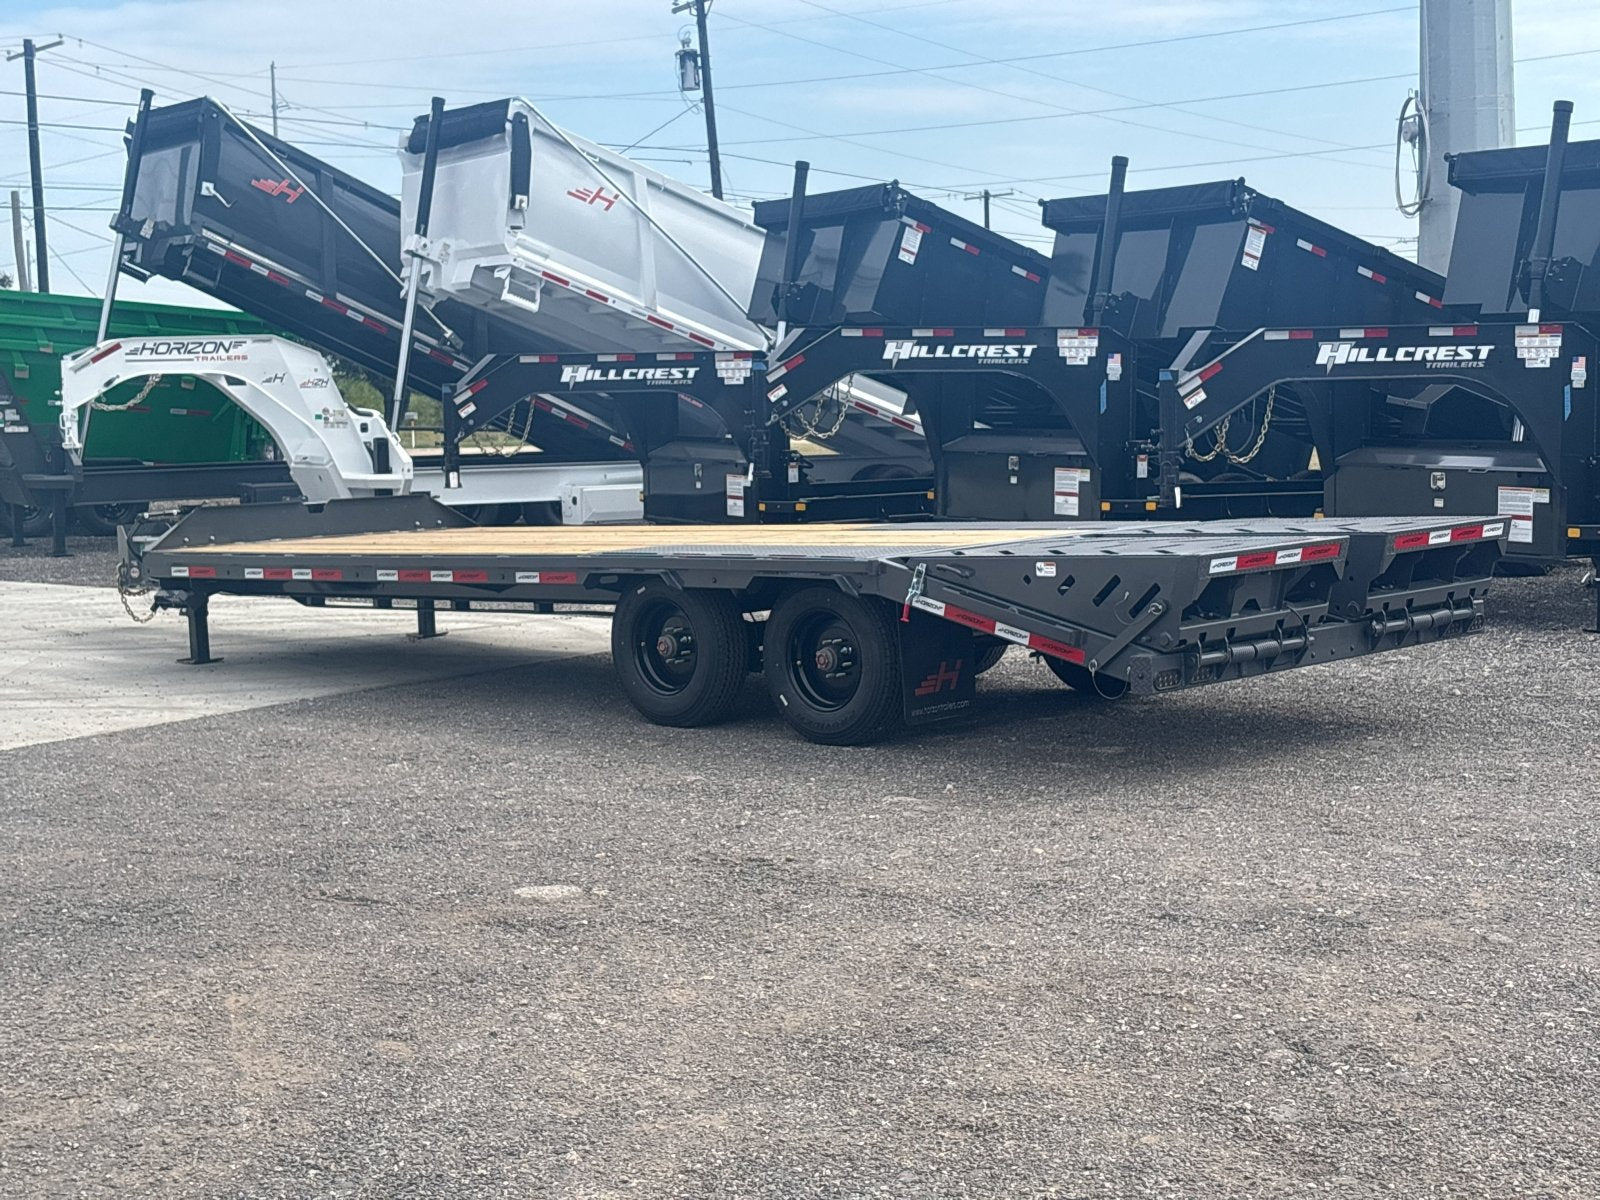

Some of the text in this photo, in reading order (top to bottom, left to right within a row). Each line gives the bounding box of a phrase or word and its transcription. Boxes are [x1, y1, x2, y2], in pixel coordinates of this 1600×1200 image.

[139, 341, 234, 356] HORIZON
[882, 340, 1037, 361] HILLCREST
[1315, 342, 1495, 366] HILLCREST
[560, 365, 700, 384] HILLCREST
[1426, 361, 1486, 369] TRAILERS
